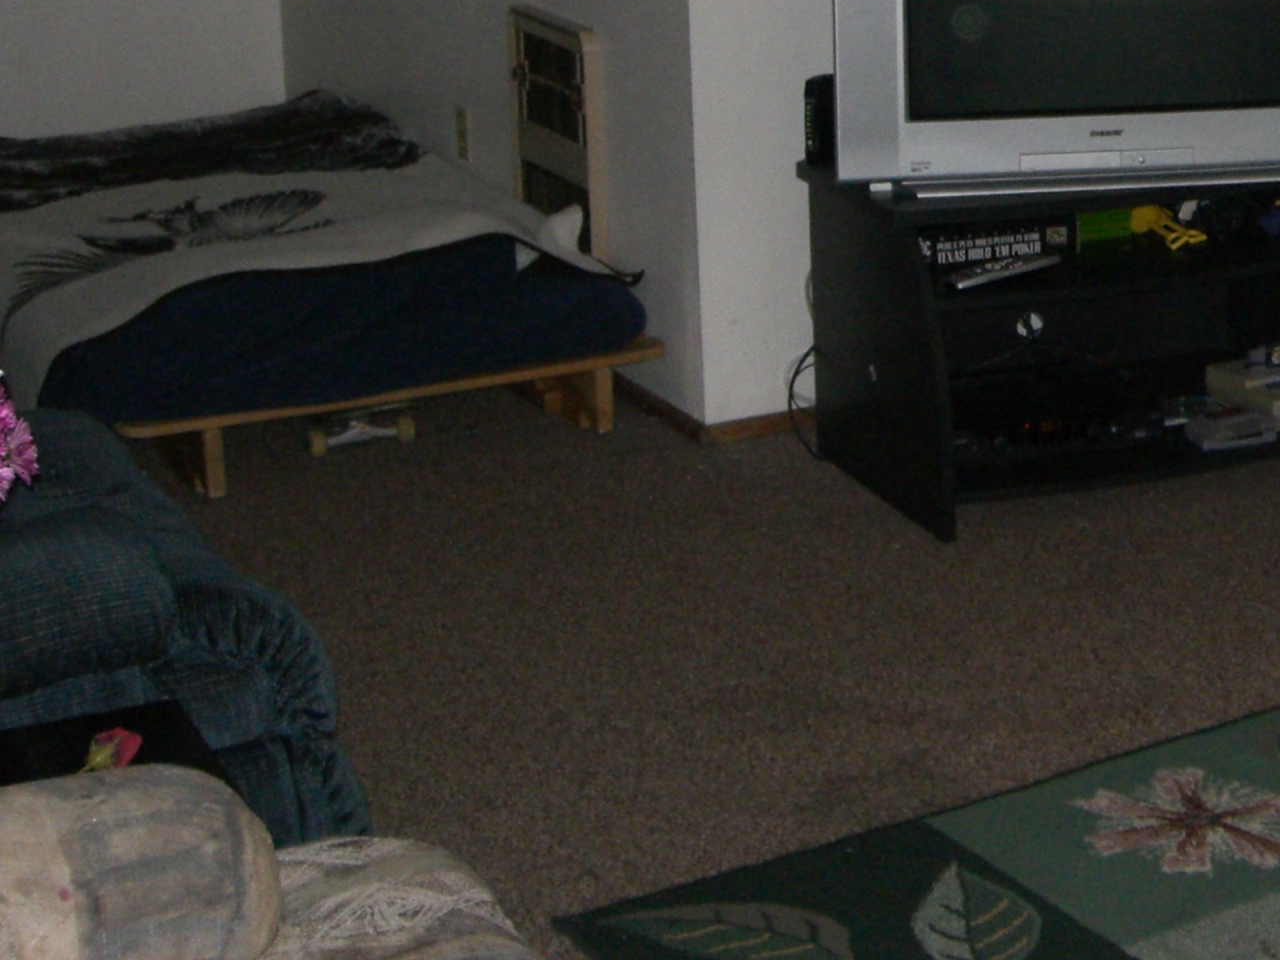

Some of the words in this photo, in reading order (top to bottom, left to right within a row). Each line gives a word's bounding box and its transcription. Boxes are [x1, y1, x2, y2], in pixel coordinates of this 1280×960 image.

[936, 249, 966, 265] TEXAS
[968, 246, 992, 259] HOLD
[1011, 241, 1042, 256] POKER
